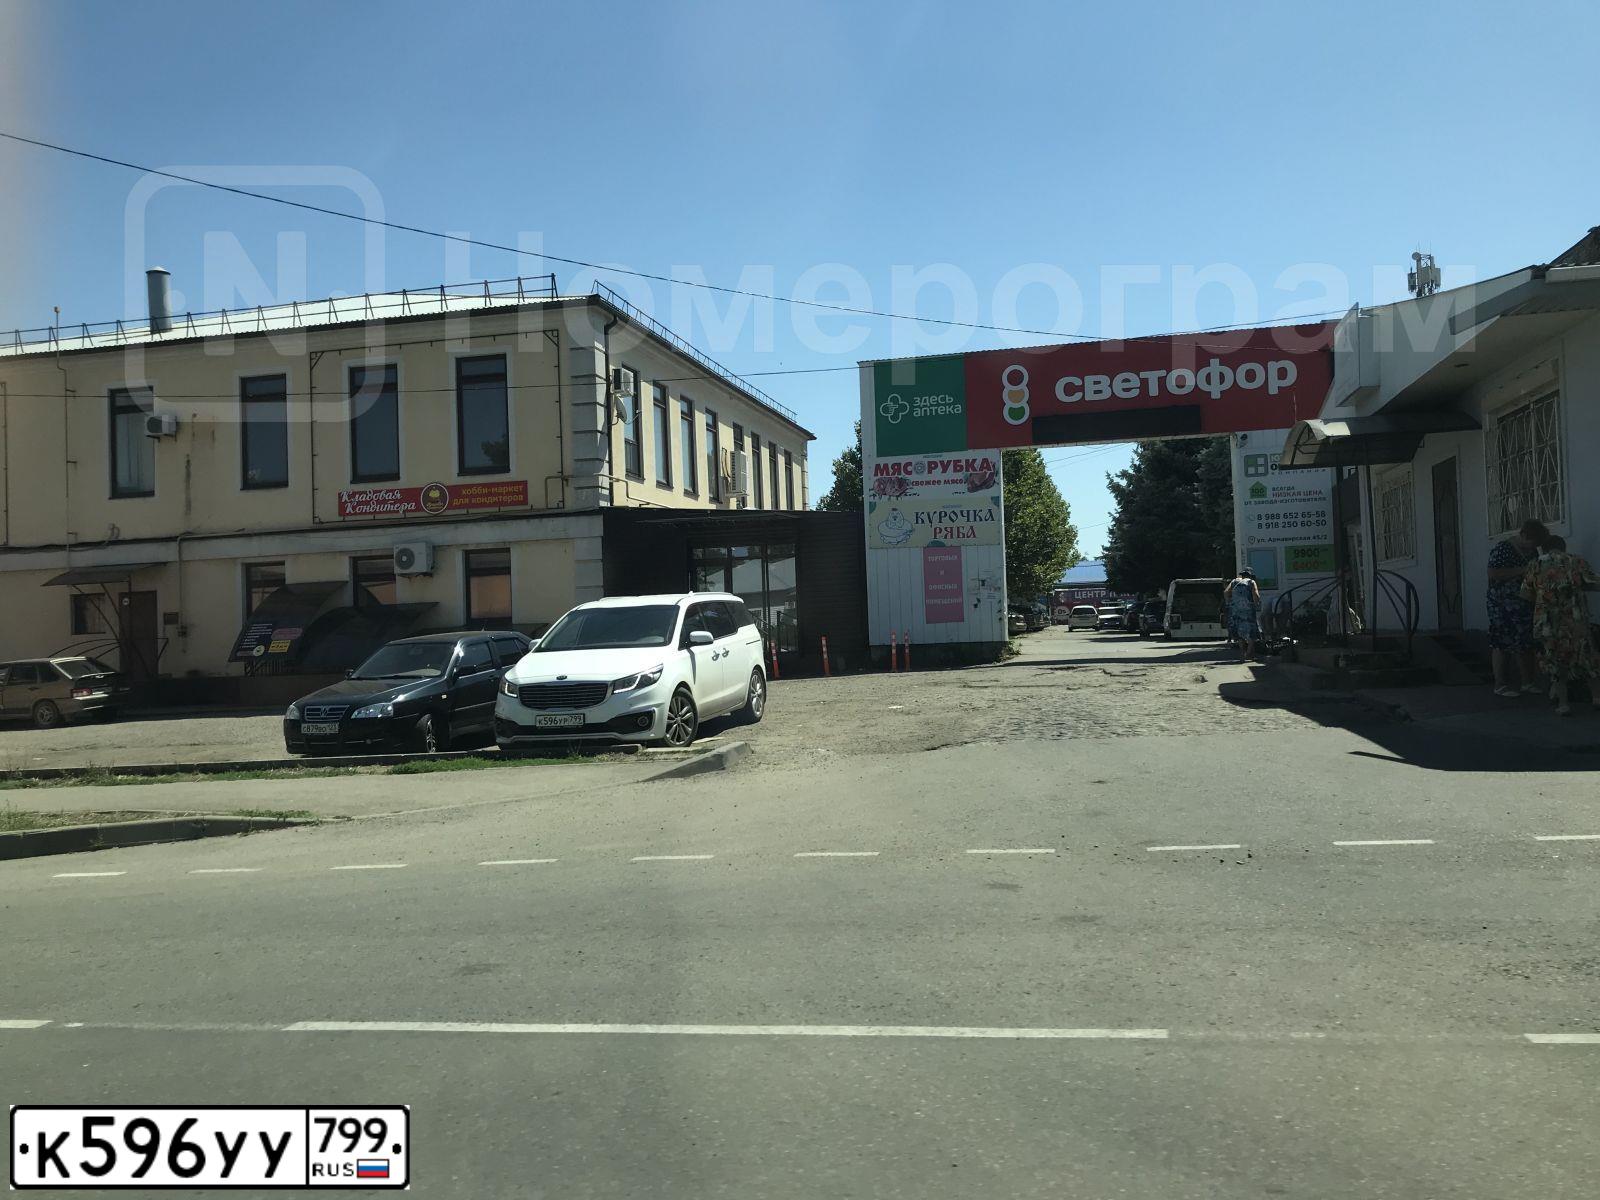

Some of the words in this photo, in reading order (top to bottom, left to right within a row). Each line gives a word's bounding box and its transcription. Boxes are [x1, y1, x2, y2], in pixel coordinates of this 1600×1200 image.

[1055, 359, 1298, 403] светофор
[913, 394, 954, 406] здесь
[913, 404, 962, 417] аптека
[911, 479, 942, 487] свежее
[341, 488, 403, 503] Кладовая
[461, 485, 523, 496] хобби-маркет
[1303, 489, 1324, 497] ЦЕНА
[345, 499, 417, 516] Кондитера
[452, 497, 468, 506] для
[471, 494, 524, 504] кондитеров
[914, 508, 995, 528] КУРОЧКА
[1282, 521, 1298, 529] 250
[1300, 519, 1327, 527] 60-50
[932, 526, 977, 539] РЯБА
[1074, 590, 1107, 599] ЦЕНТР
